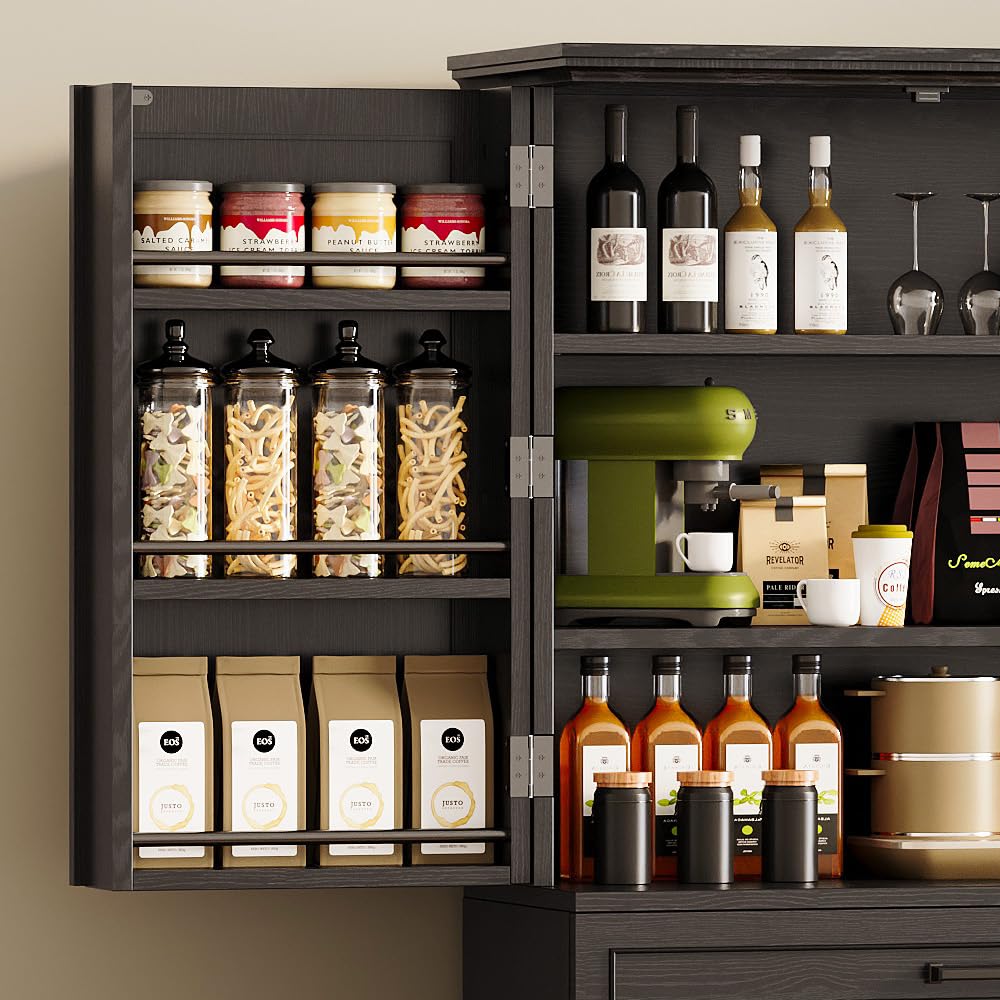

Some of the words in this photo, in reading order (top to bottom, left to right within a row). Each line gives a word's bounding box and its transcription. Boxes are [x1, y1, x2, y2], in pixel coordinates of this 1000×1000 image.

[766, 555, 804, 565] REVELATOR
[160, 803, 183, 813] JUSTO
[253, 802, 276, 812] JUSTO
[350, 801, 373, 810] JUSTO
[442, 800, 465, 809] JUSTO
